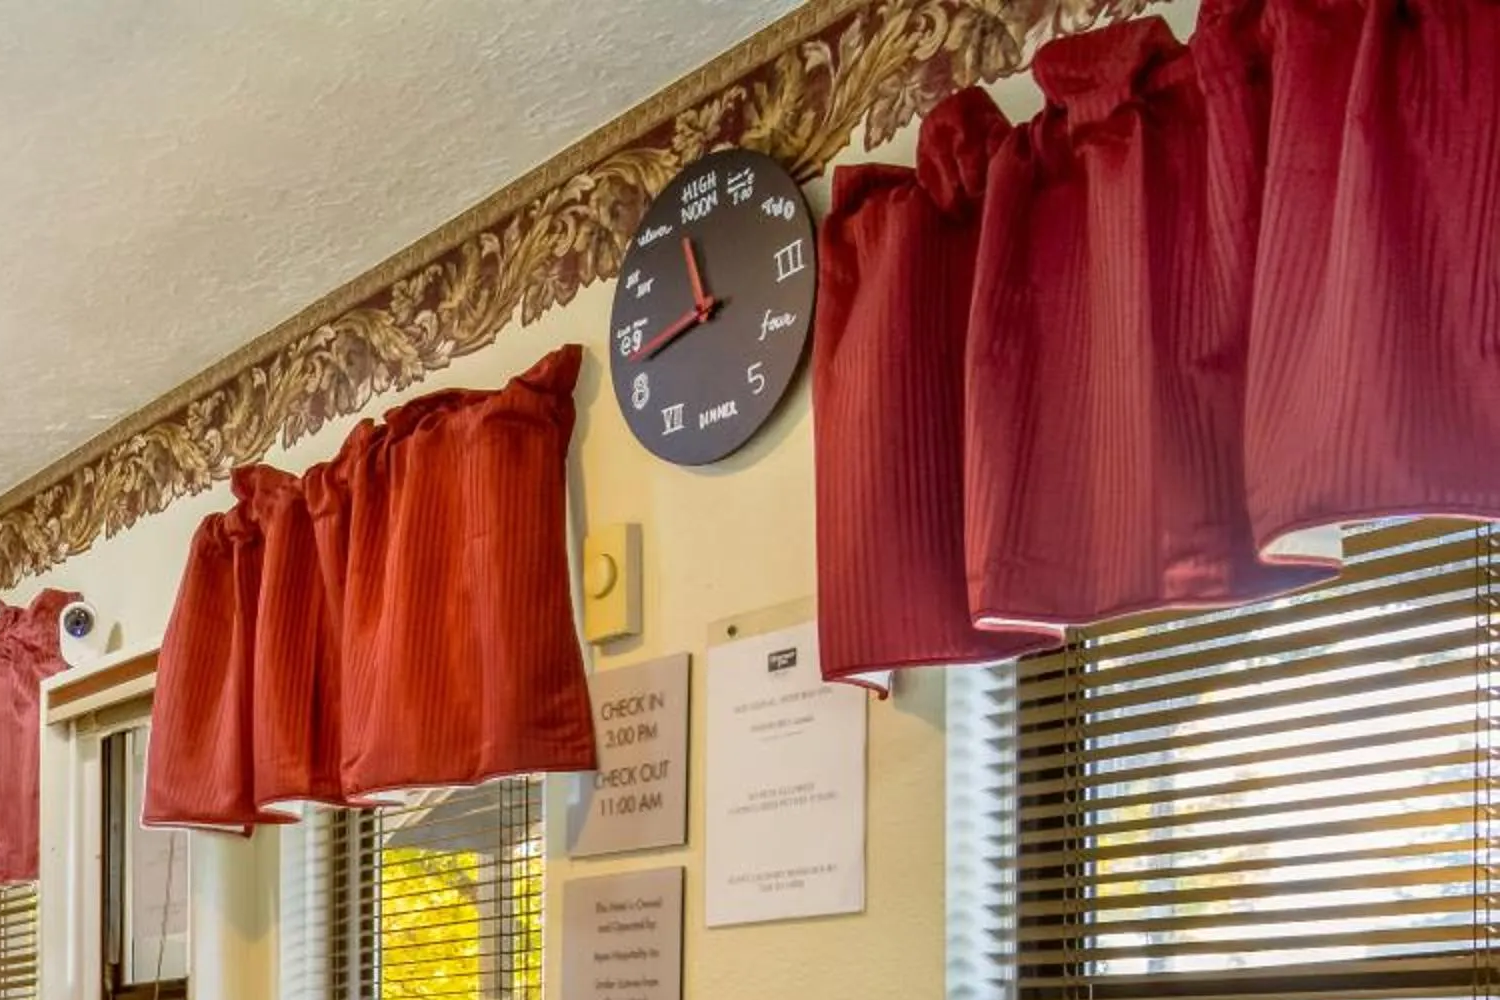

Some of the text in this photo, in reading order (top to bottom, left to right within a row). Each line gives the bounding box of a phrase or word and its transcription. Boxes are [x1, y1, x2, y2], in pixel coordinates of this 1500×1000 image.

[681, 170, 717, 204] HIGH
[681, 190, 719, 225] NOON
[758, 308, 797, 341] four
[632, 372, 650, 410] 8
[747, 361, 766, 395] 5
[699, 400, 738, 429] DINNER
[601, 691, 665, 721] CHECK IN
[637, 722, 659, 743] PM
[594, 759, 671, 790] CHECK OUT
[639, 791, 663, 813] AM
